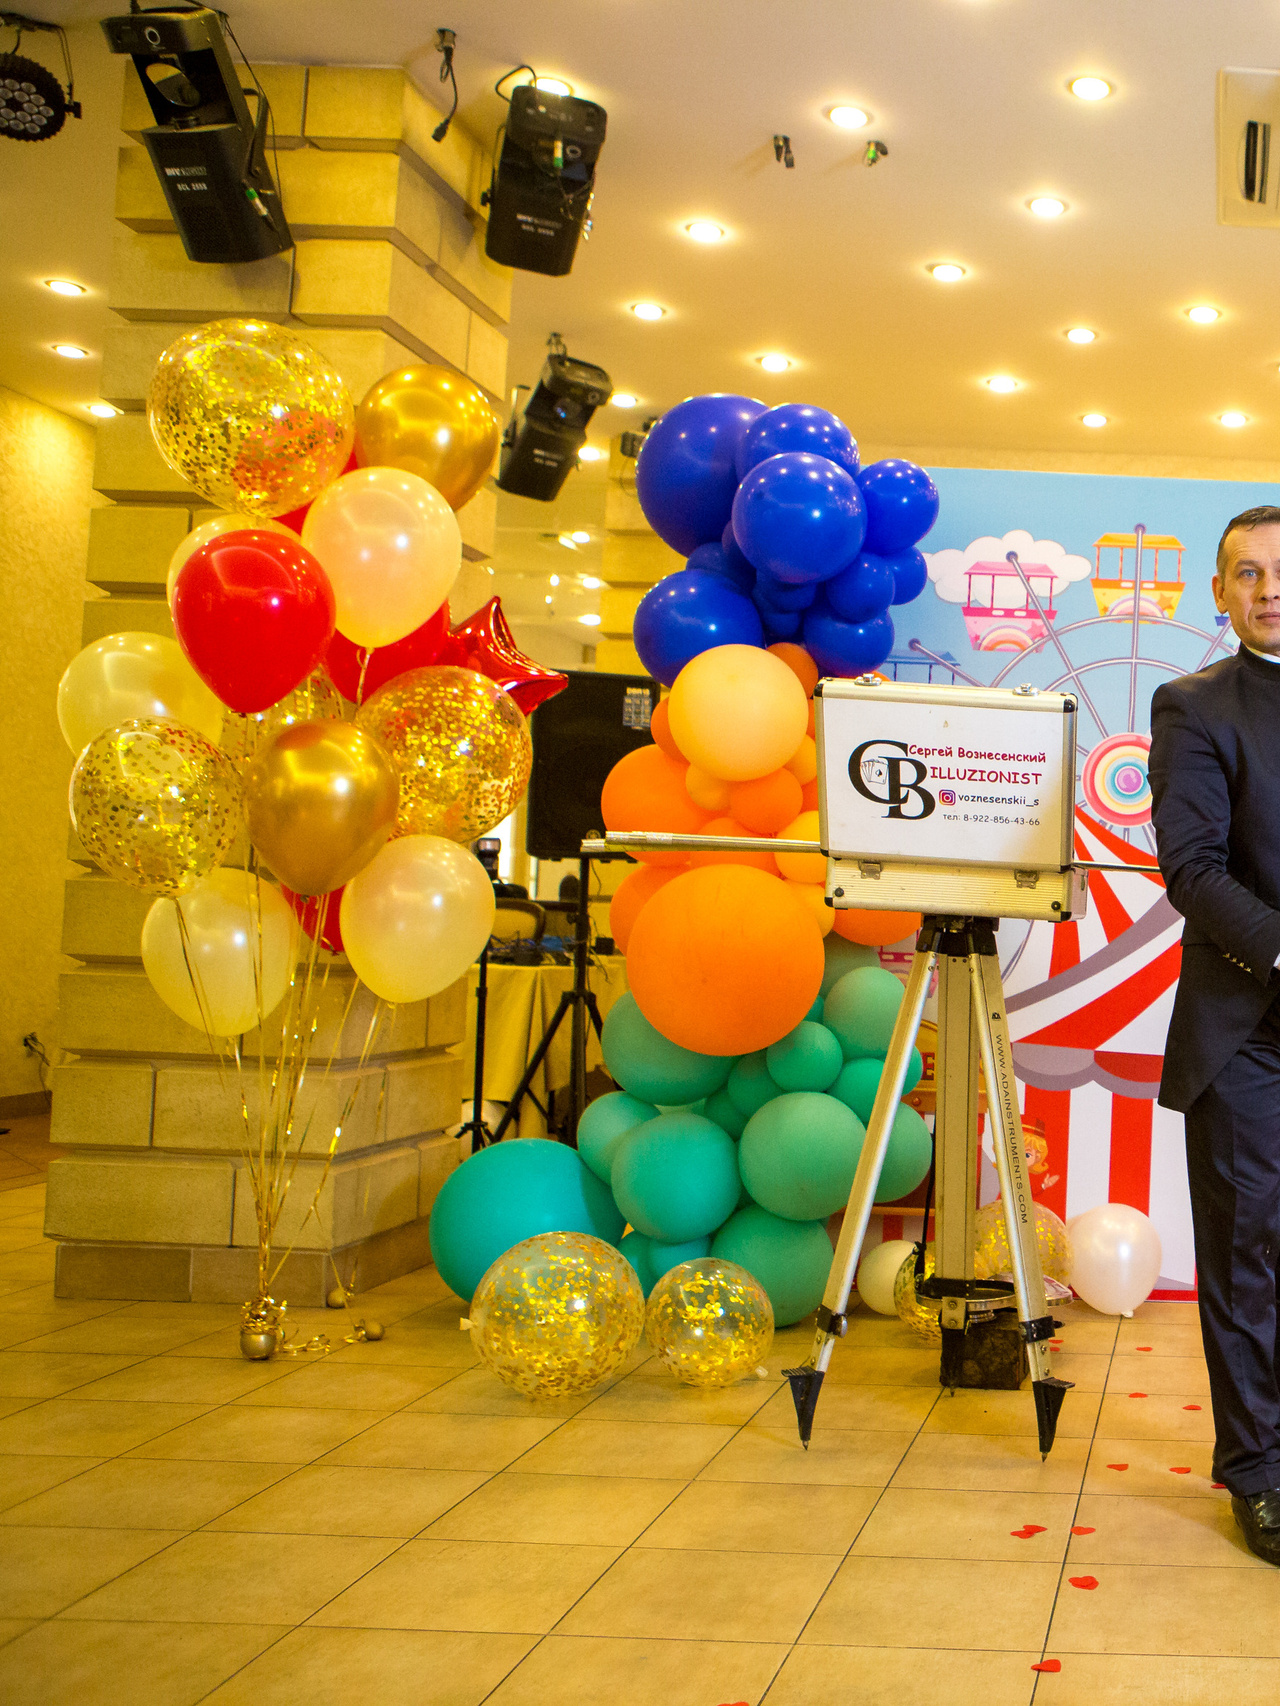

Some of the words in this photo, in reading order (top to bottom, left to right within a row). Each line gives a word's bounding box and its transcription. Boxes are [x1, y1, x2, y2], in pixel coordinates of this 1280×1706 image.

[909, 744, 953, 758] Сергей
[957, 747, 1046, 763] Вознесенский
[930, 766, 1042, 785] ILLUZIONIST
[958, 793, 1039, 807] voznesenskii_s
[943, 813, 961, 821] тел:
[963, 813, 1040, 826] 8-922-856-43-66
[996, 1034, 1028, 1224] WWW.ADAINSTRUMENTS.COM
